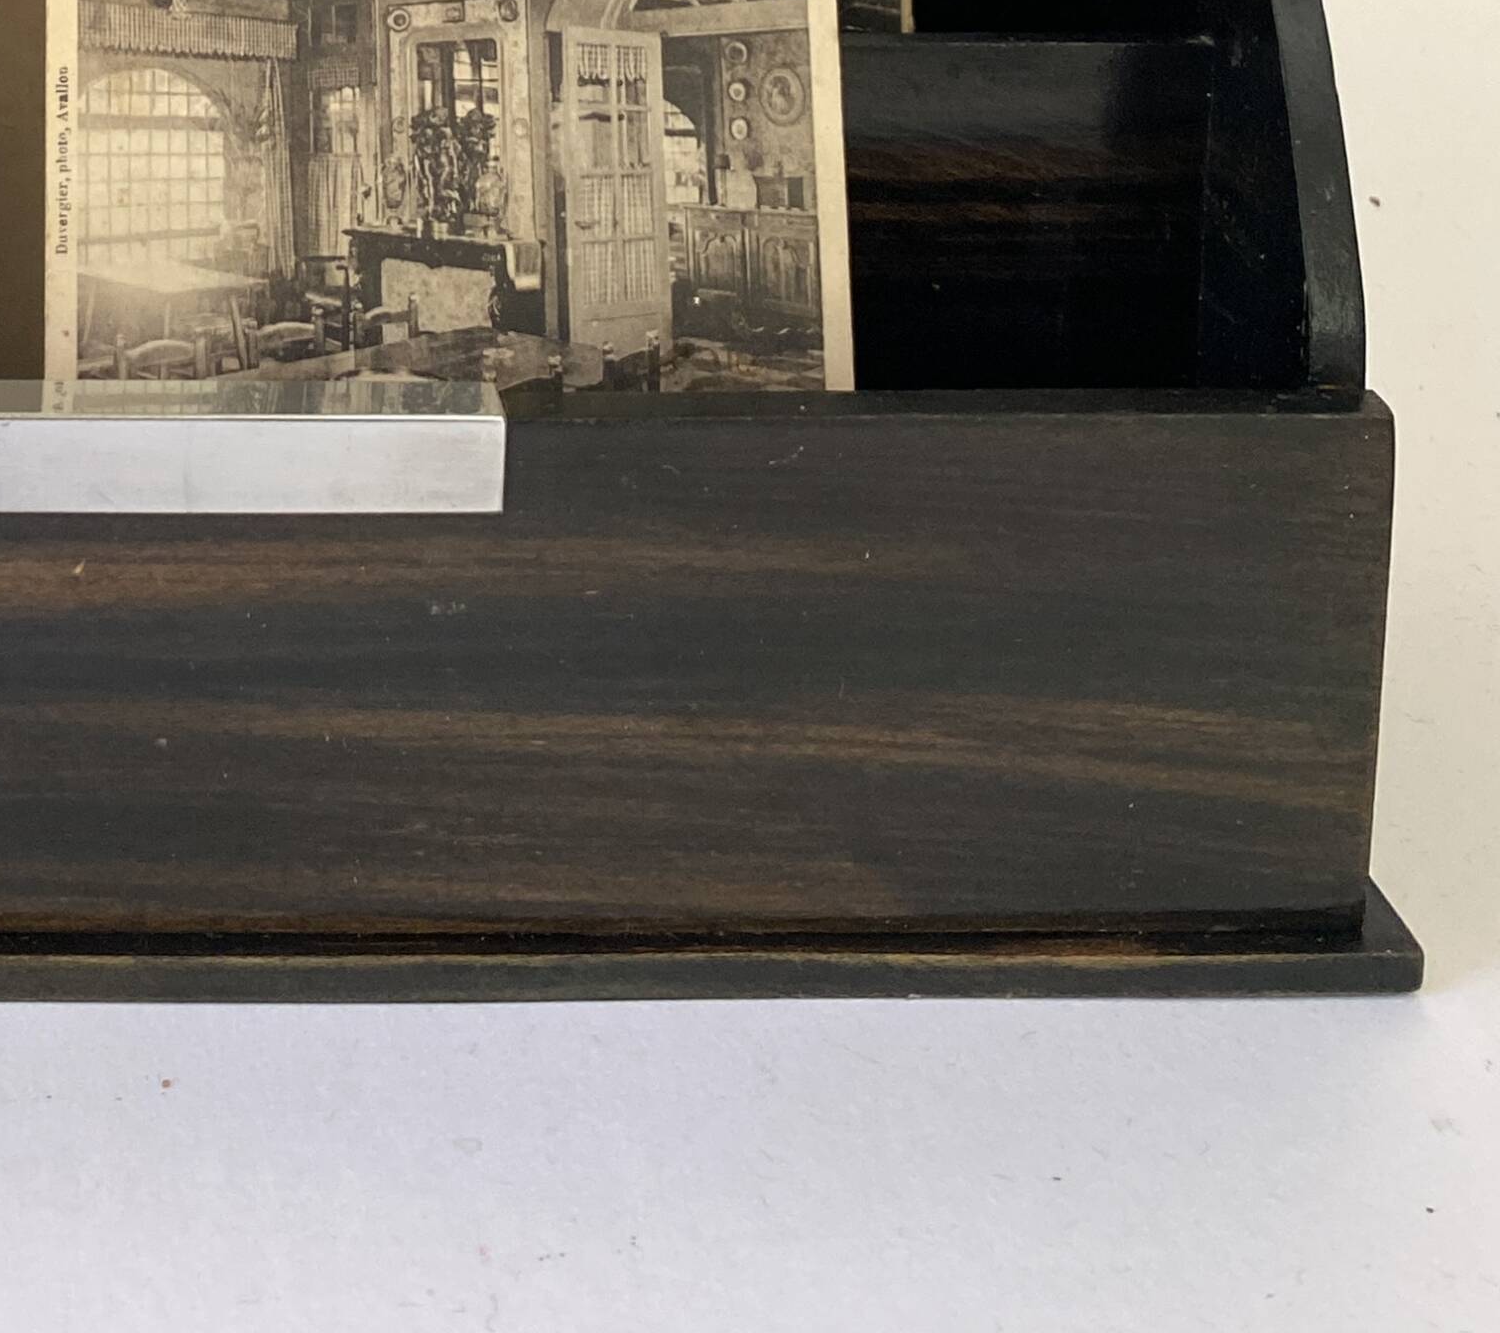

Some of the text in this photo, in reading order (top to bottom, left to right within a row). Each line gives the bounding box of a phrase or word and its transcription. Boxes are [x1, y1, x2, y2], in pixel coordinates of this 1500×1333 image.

[55, 66, 71, 255] Duvergier, photo, Avallon
